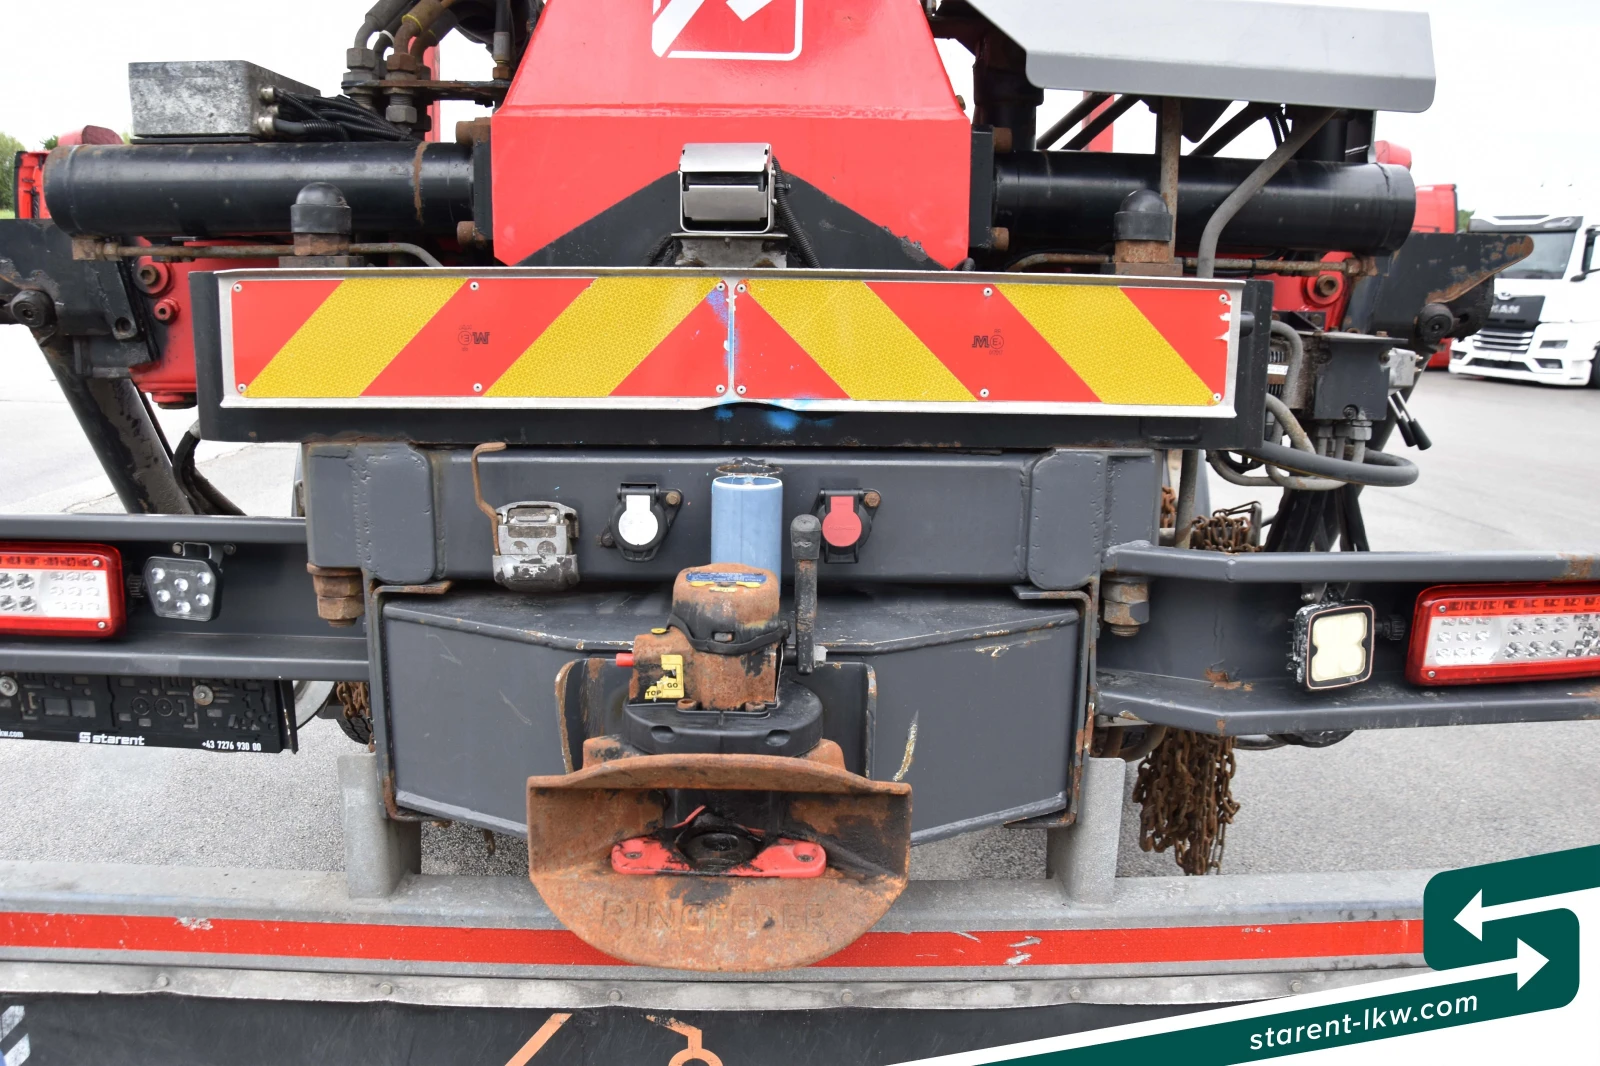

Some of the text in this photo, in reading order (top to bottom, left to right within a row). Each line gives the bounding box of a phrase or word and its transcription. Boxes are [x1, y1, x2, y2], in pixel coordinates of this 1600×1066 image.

[92, 733, 145, 746] starent
[202, 740, 262, 751] +43 7276 930 00
[602, 900, 824, 932] RINGFEDER
